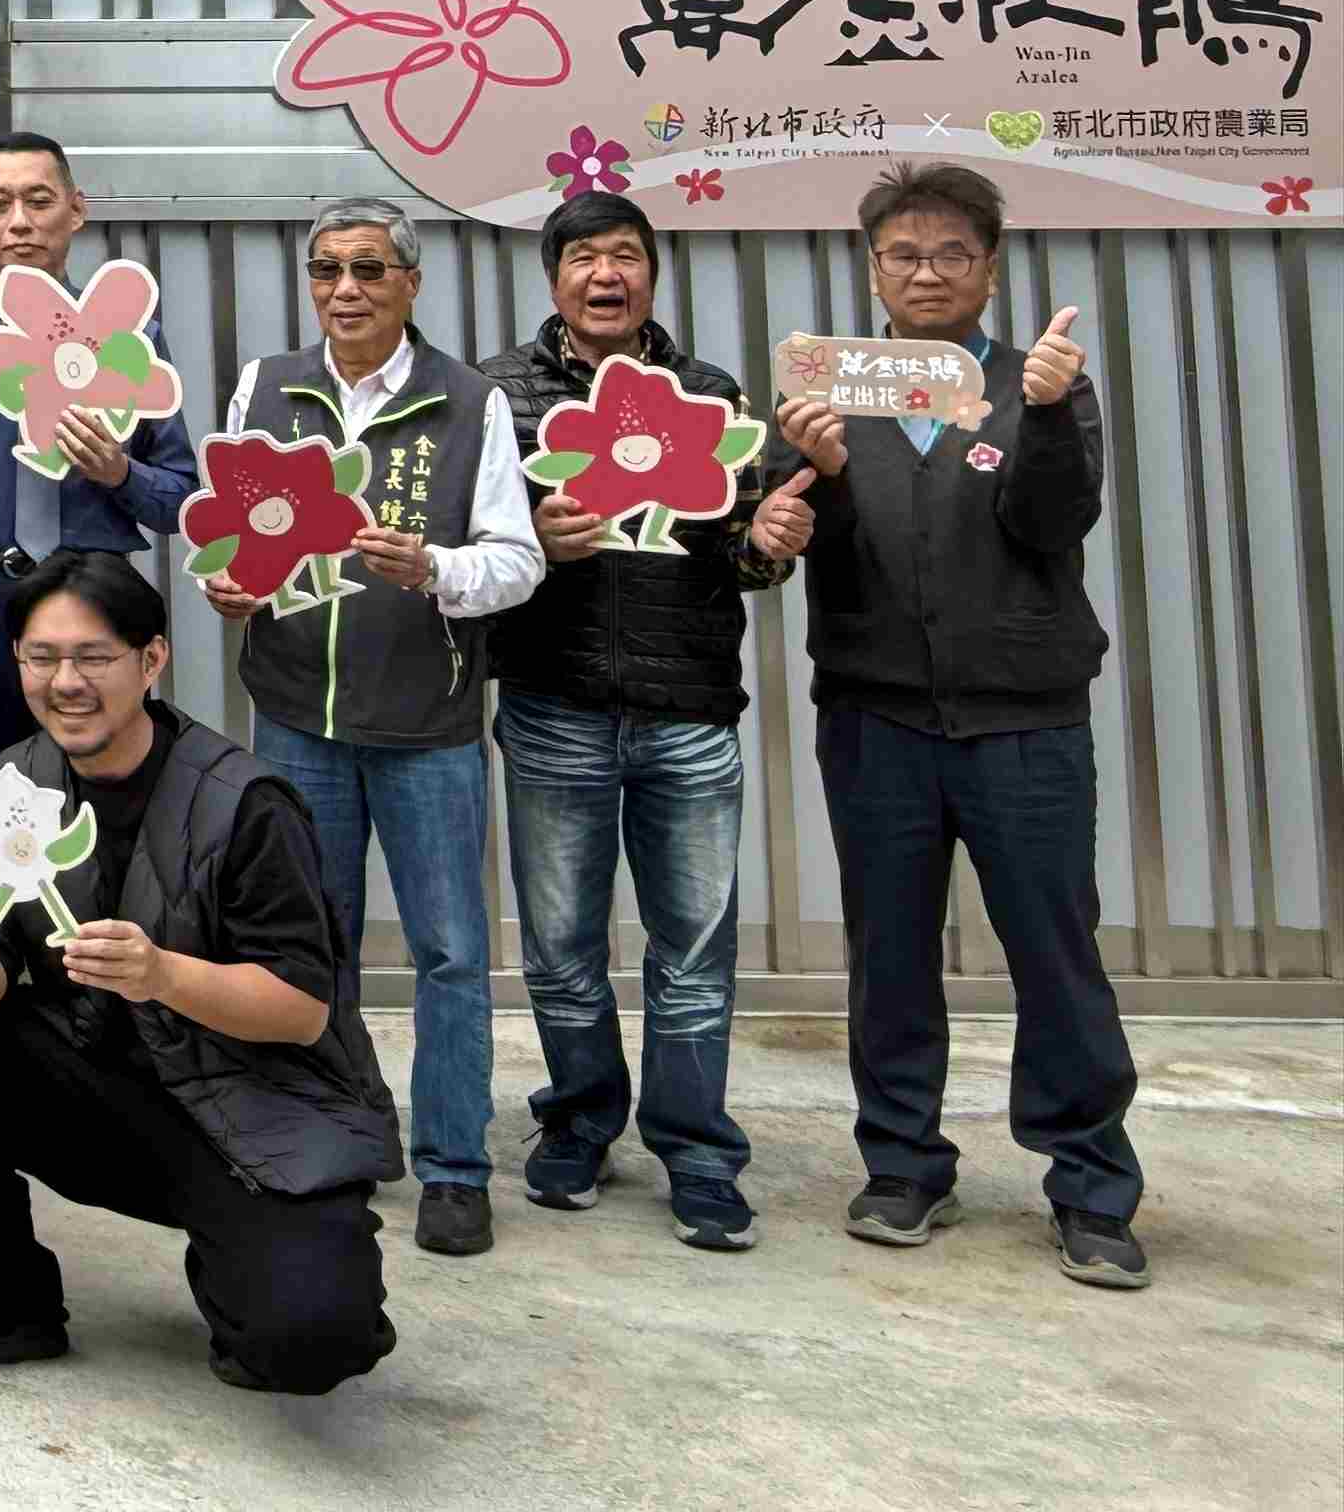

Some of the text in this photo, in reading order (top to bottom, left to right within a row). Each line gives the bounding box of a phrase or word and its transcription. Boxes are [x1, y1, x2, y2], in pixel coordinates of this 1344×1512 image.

[1015, 45, 1091, 62] Wan-Jin
[698, 103, 886, 144] 新北市政府
[1052, 108, 1310, 138] 新北市政府農業局
[806, 385, 901, 411] 一起出花
